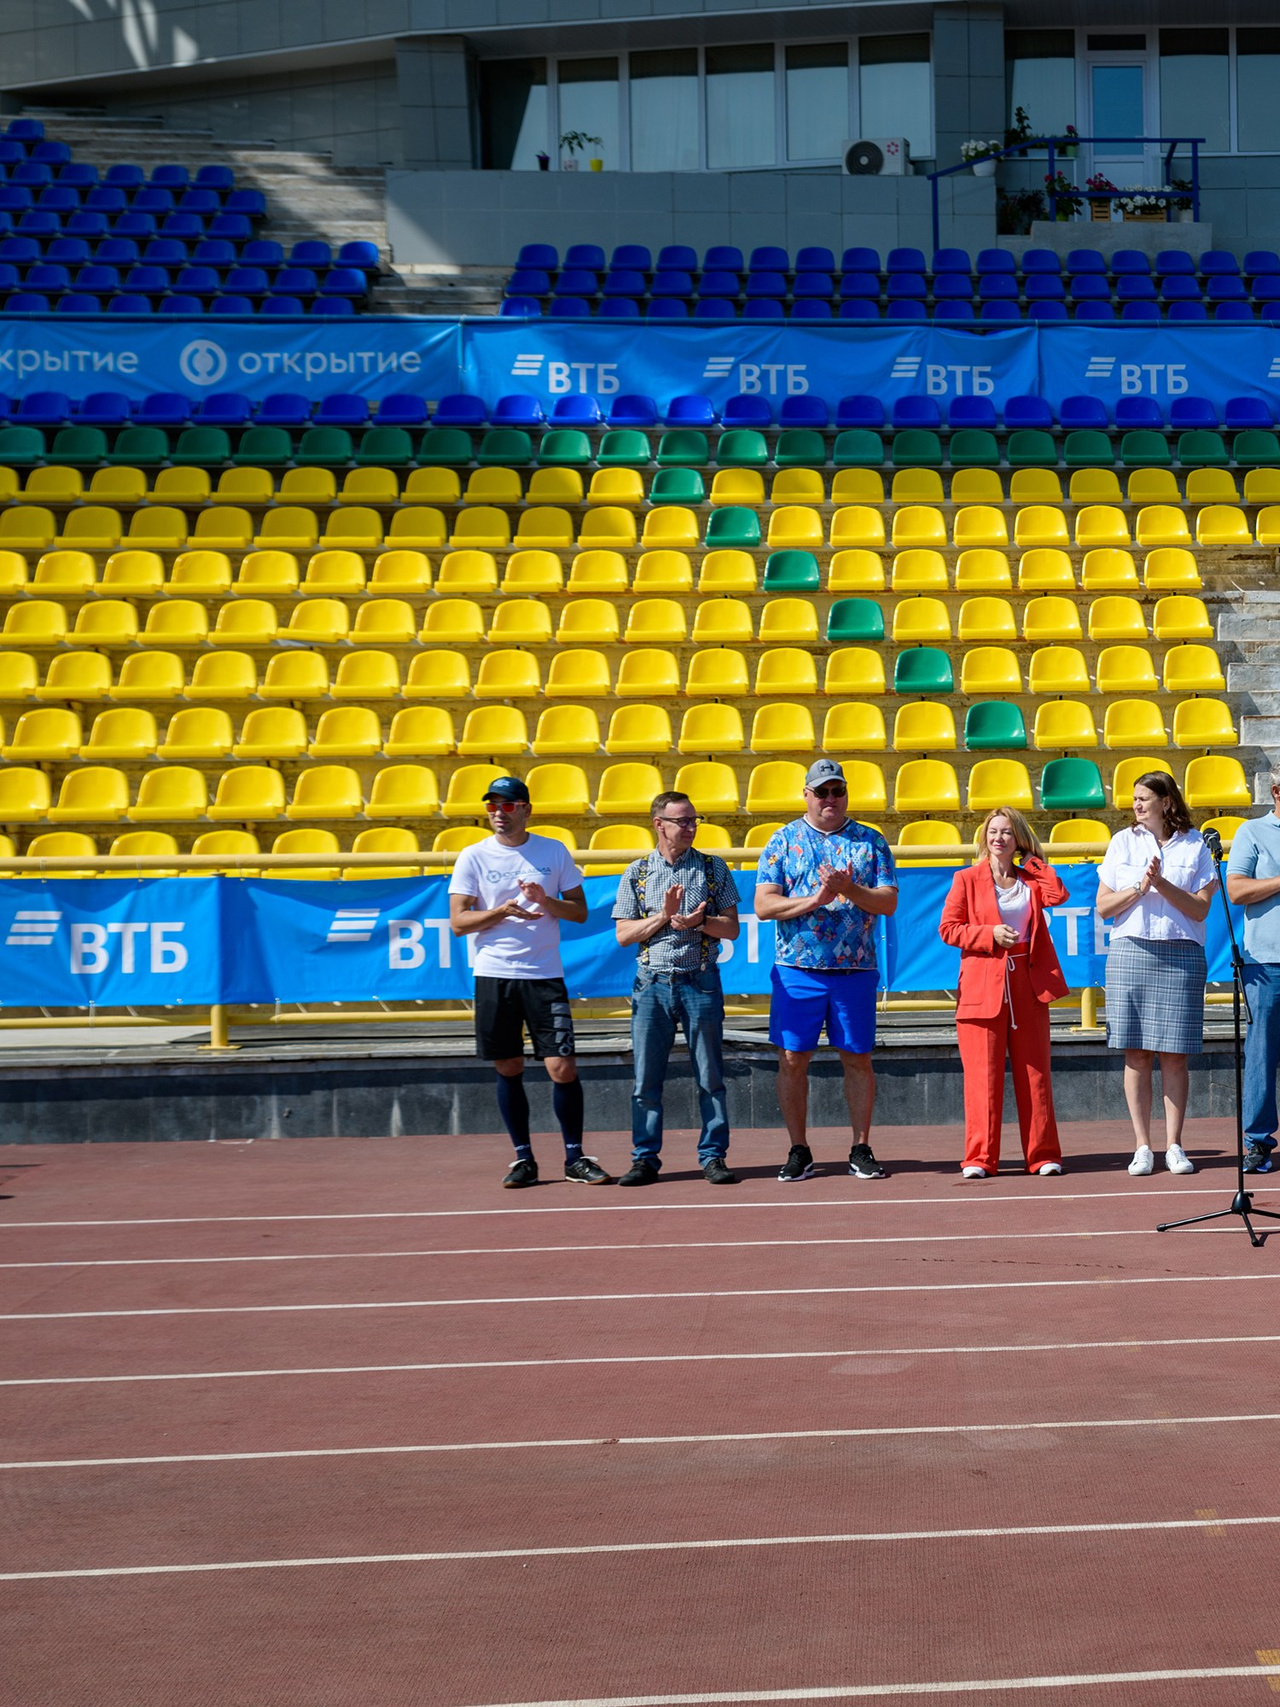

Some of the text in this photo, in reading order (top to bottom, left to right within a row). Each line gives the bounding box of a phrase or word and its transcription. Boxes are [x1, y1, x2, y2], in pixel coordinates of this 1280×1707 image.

[238, 351, 422, 382] открытие
[548, 362, 619, 394] ВТБ
[738, 363, 809, 395] ВТБ
[926, 364, 995, 395] ВТБ
[1120, 364, 1189, 395] ВТБ
[70, 921, 188, 975] ВТБ
